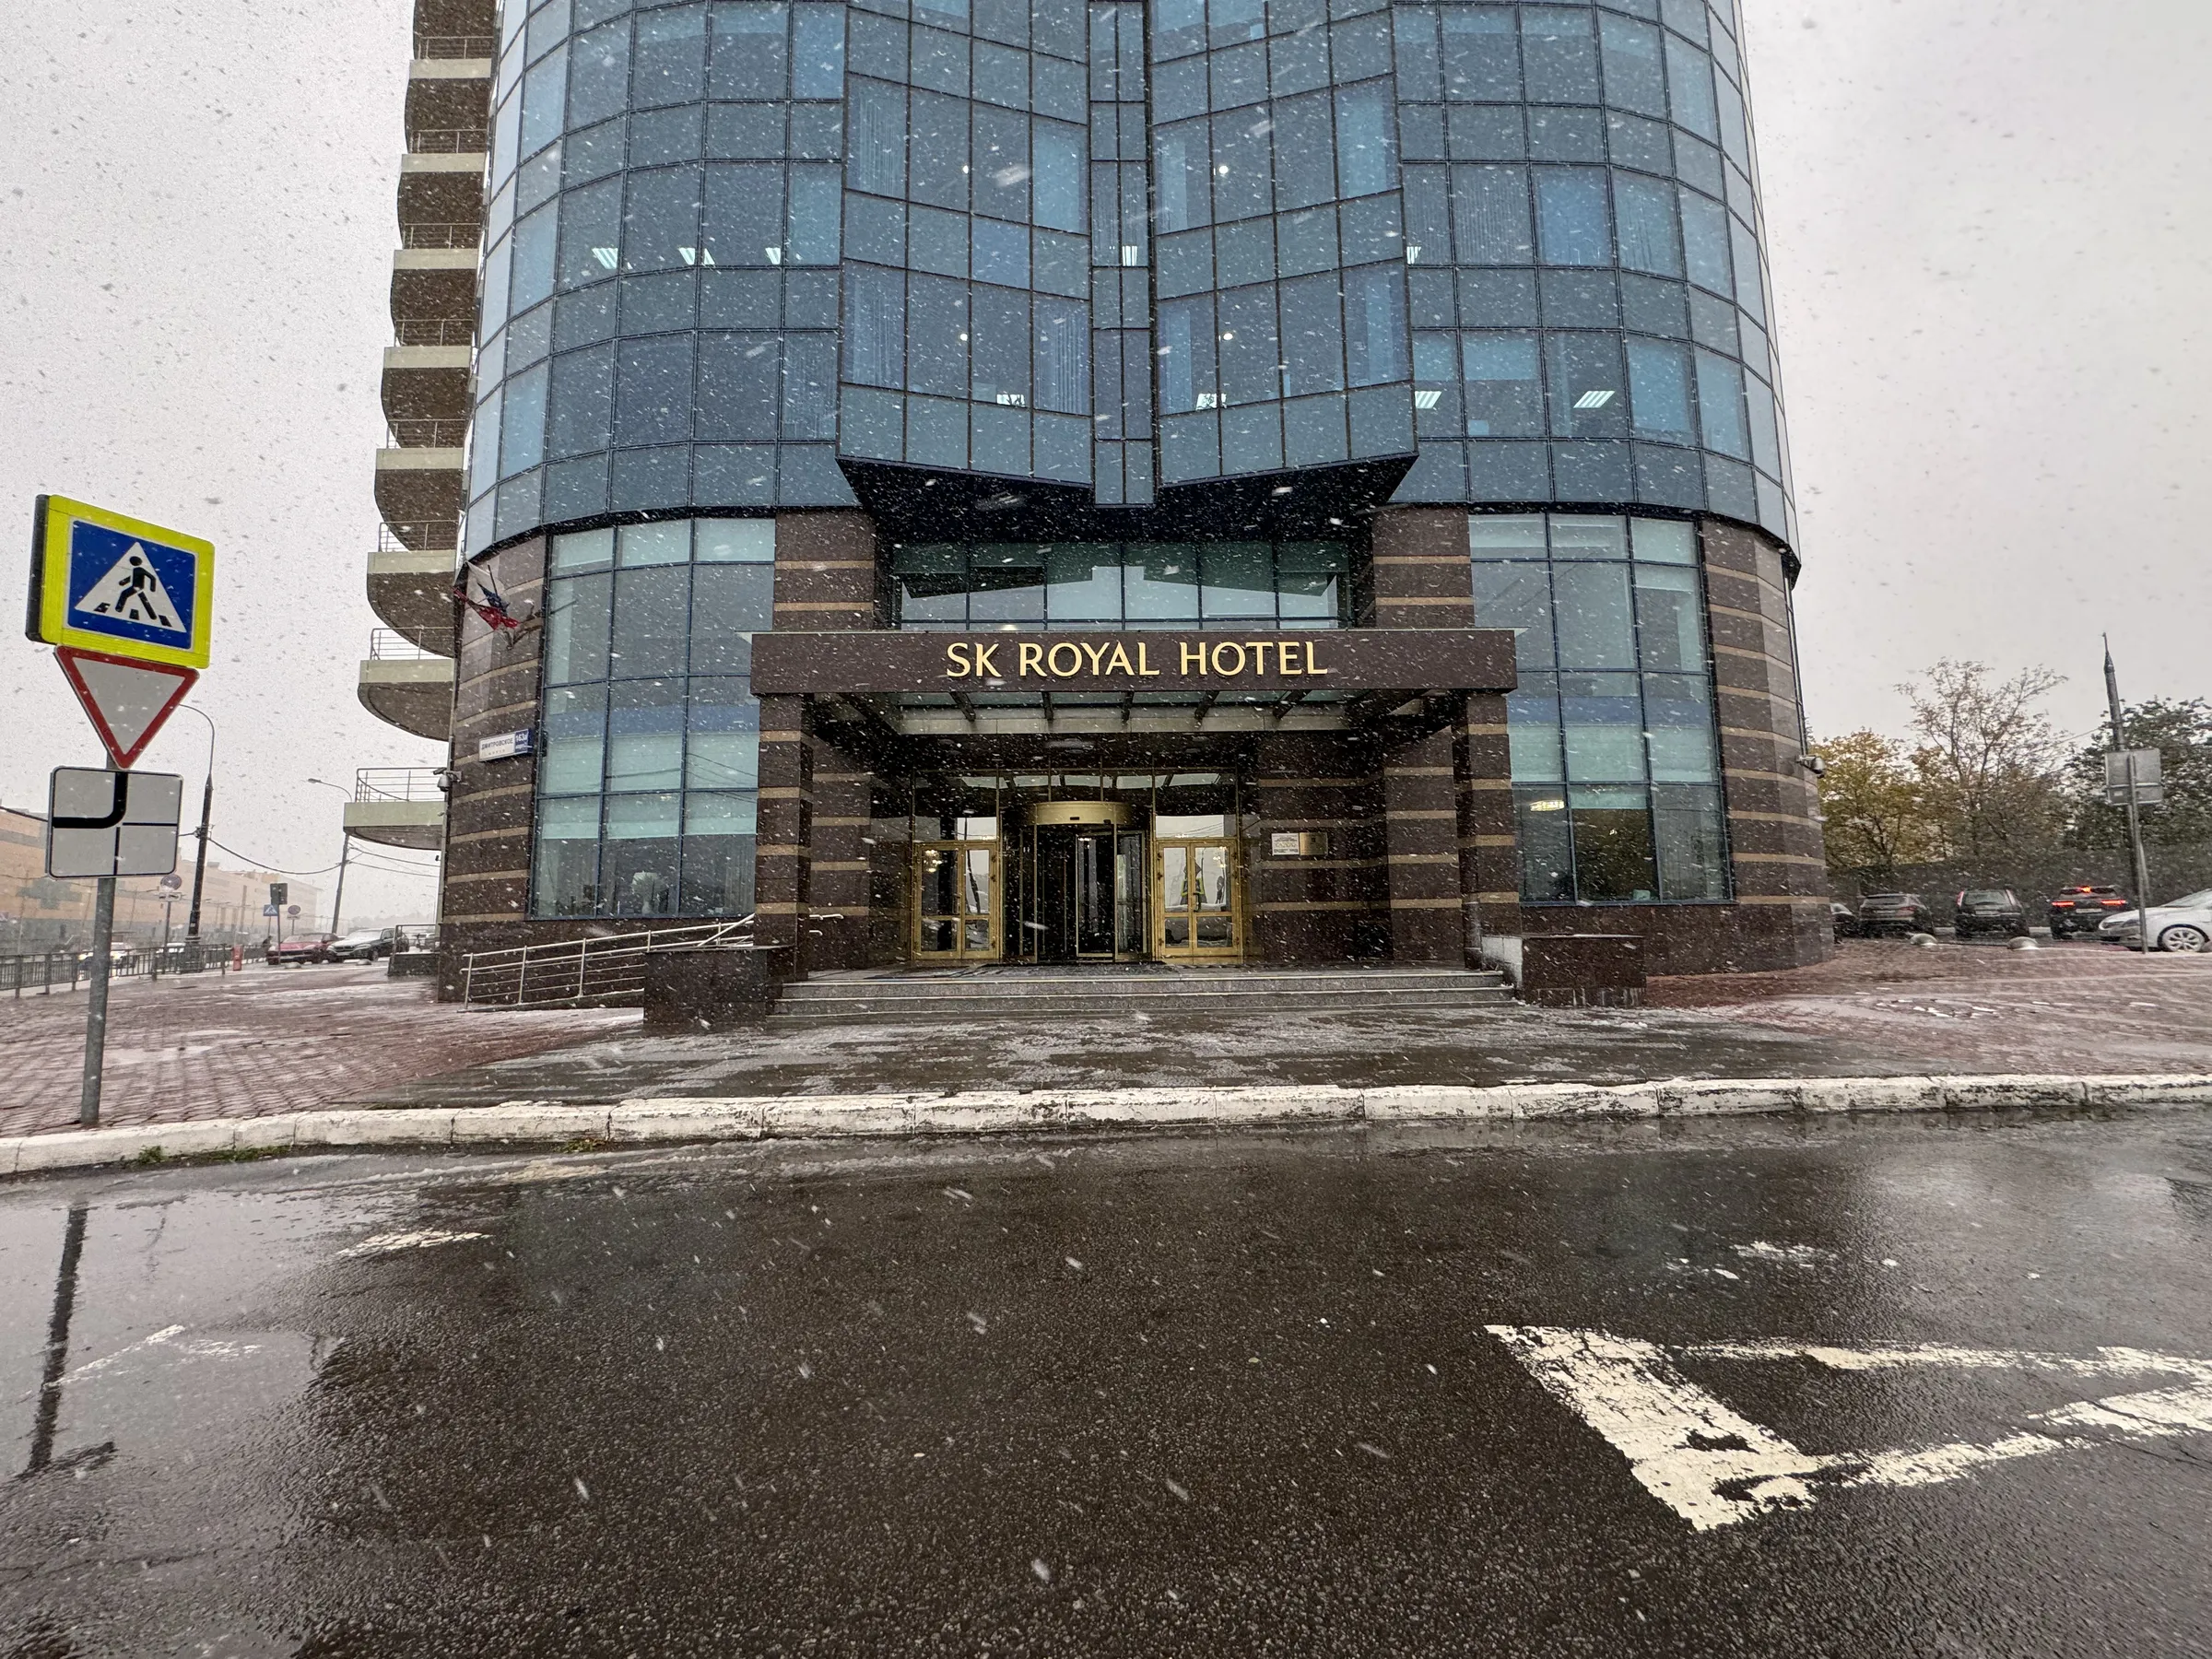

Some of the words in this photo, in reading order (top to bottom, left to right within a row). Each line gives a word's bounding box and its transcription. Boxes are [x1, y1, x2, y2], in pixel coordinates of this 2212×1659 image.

[947, 642, 1002, 677] SK
[1018, 641, 1160, 677] ROYAL
[1180, 641, 1328, 677] HOTEL
